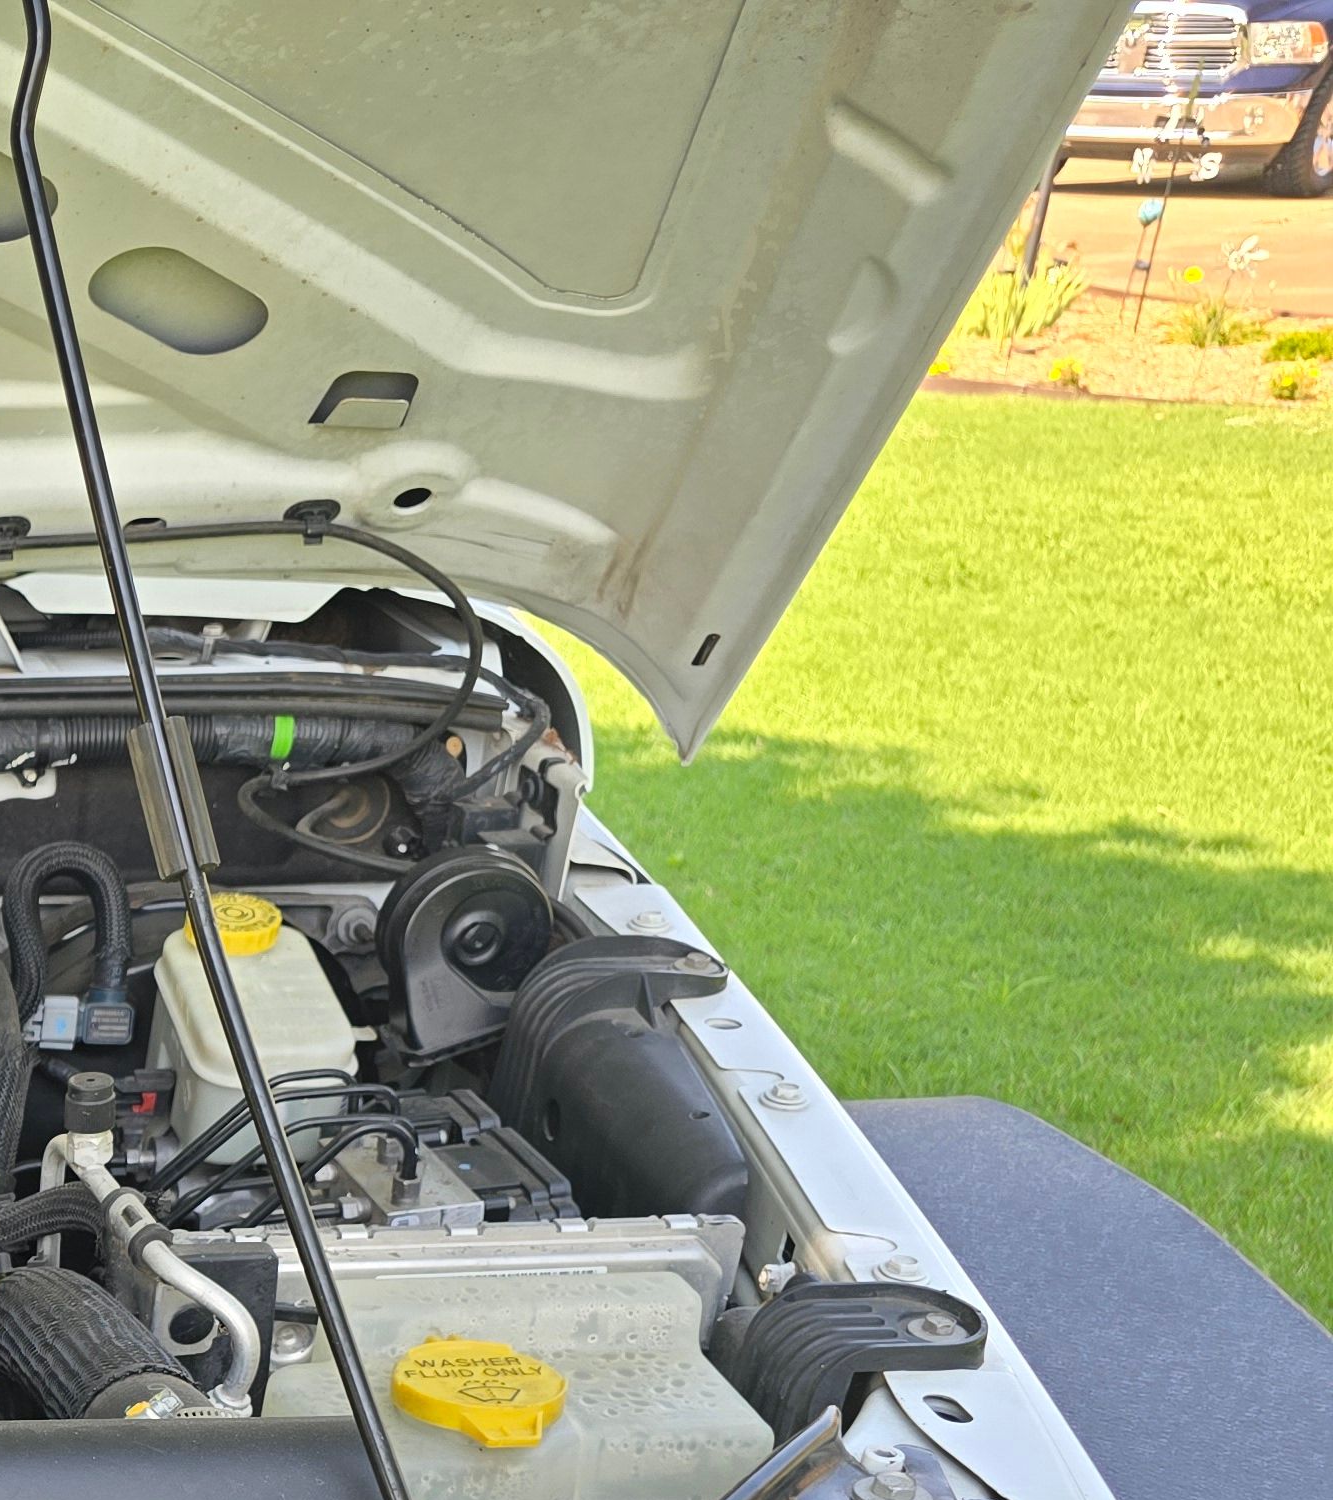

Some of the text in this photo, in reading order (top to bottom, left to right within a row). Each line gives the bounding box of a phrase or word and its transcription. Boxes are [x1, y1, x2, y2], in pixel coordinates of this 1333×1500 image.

[414, 1356, 522, 1368] WASHER
[403, 1366, 542, 1379] FLUID ONLY
